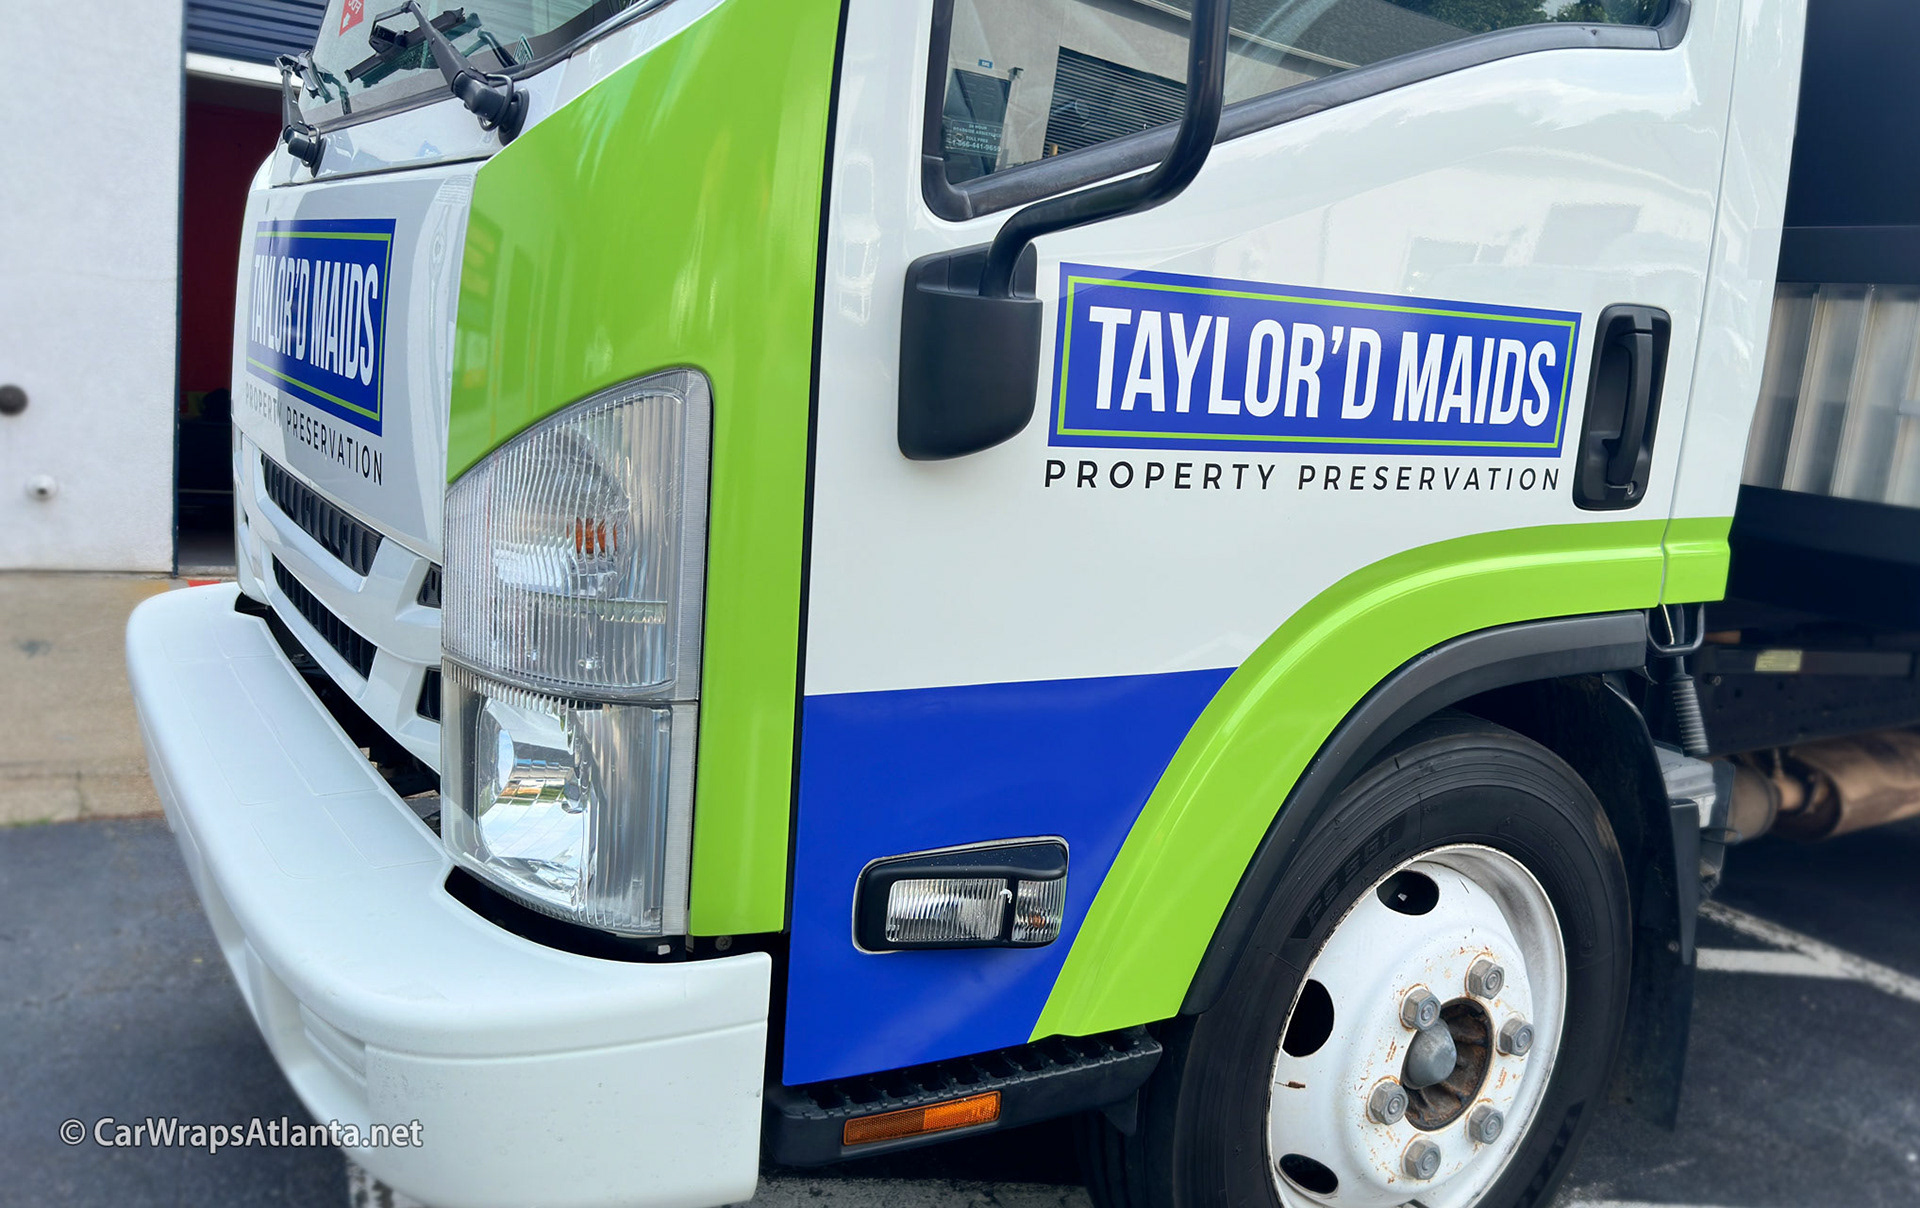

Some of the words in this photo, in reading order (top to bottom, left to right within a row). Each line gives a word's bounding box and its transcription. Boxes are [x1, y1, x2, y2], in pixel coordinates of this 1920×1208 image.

[310, 260, 378, 386] MAIDS
[1392, 331, 1556, 427] MAIDS
[245, 381, 283, 428] PROPERTY
[286, 405, 383, 486] PRESERVATION
[1044, 460, 1276, 489] PROPERTY
[1298, 465, 1560, 491] PRESERVATION
